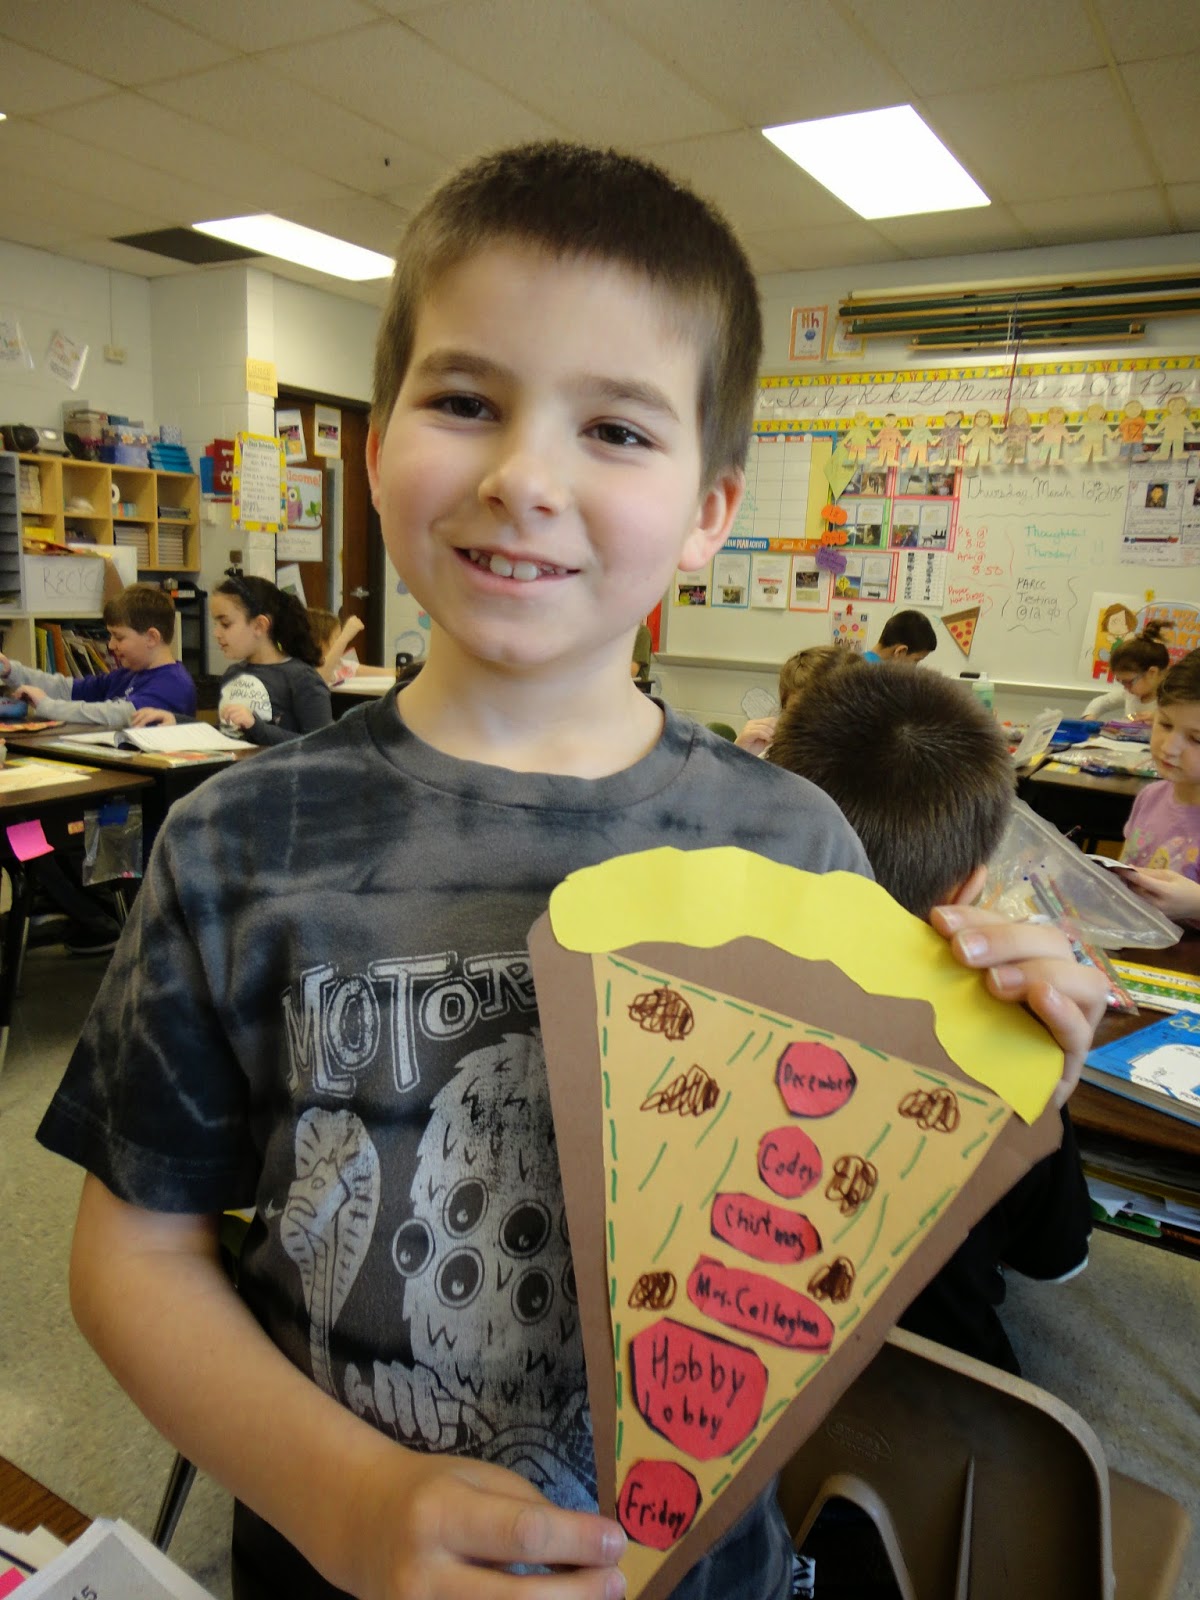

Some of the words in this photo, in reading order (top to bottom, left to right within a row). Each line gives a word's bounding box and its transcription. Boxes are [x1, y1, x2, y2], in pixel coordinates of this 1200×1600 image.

[287, 470, 321, 487] lcome!
[1033, 476, 1072, 498] March
[1016, 577, 1047, 590] PARCC
[1017, 592, 1058, 609] Testing
[652, 1335, 745, 1407] Hobby
[625, 1482, 687, 1538] Friday
